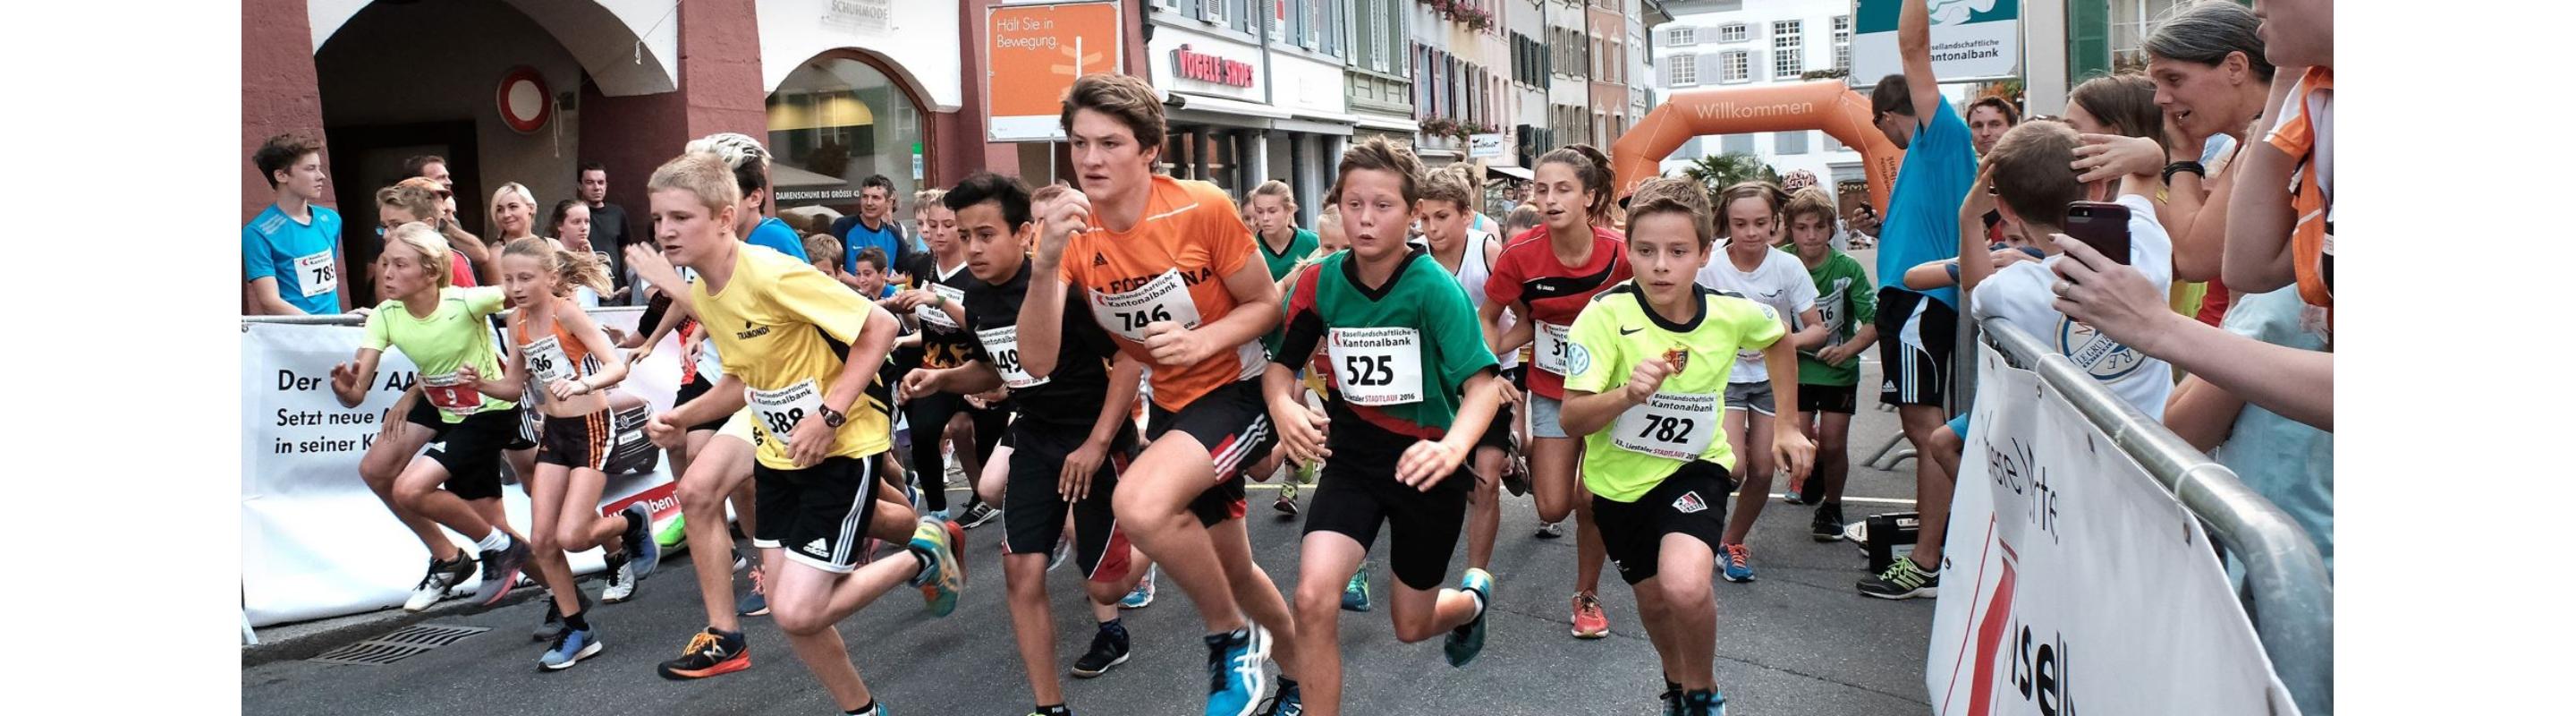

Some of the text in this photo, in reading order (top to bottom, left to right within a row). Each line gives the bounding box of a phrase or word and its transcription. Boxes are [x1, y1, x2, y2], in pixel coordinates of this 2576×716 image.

[832, 0, 888, 20] SCHUHMODE
[1022, 17, 1040, 30] Sie
[1044, 18, 1054, 29] in
[996, 34, 1059, 49] Bewegung.
[1931, 38, 1999, 51] sellandschaftliche
[1930, 48, 1999, 62] antonalbank
[1224, 59, 1254, 88] SHOES
[1695, 101, 1813, 119] Willkommen
[775, 191, 820, 200] DAMENSCHUHE
[821, 191, 830, 199] BIS
[831, 189, 852, 199] GRÖSSE
[1107, 281, 1178, 309] Kantonalbank
[1114, 303, 1172, 332] 746
[1343, 329, 1411, 337] Basellandschaftliche
[1343, 337, 1411, 348] Kantonalbank
[1346, 354, 1394, 386] 525
[278, 369, 322, 391] Der
[445, 388, 458, 405] 9
[1650, 400, 1713, 412] Kantonalbank
[276, 408, 323, 426] Setzt
[328, 412, 374, 425] neue
[763, 407, 804, 434] 388
[1639, 413, 1695, 445] 782
[275, 437, 292, 454] in
[300, 435, 356, 453] seiner
[648, 496, 674, 513] ben
